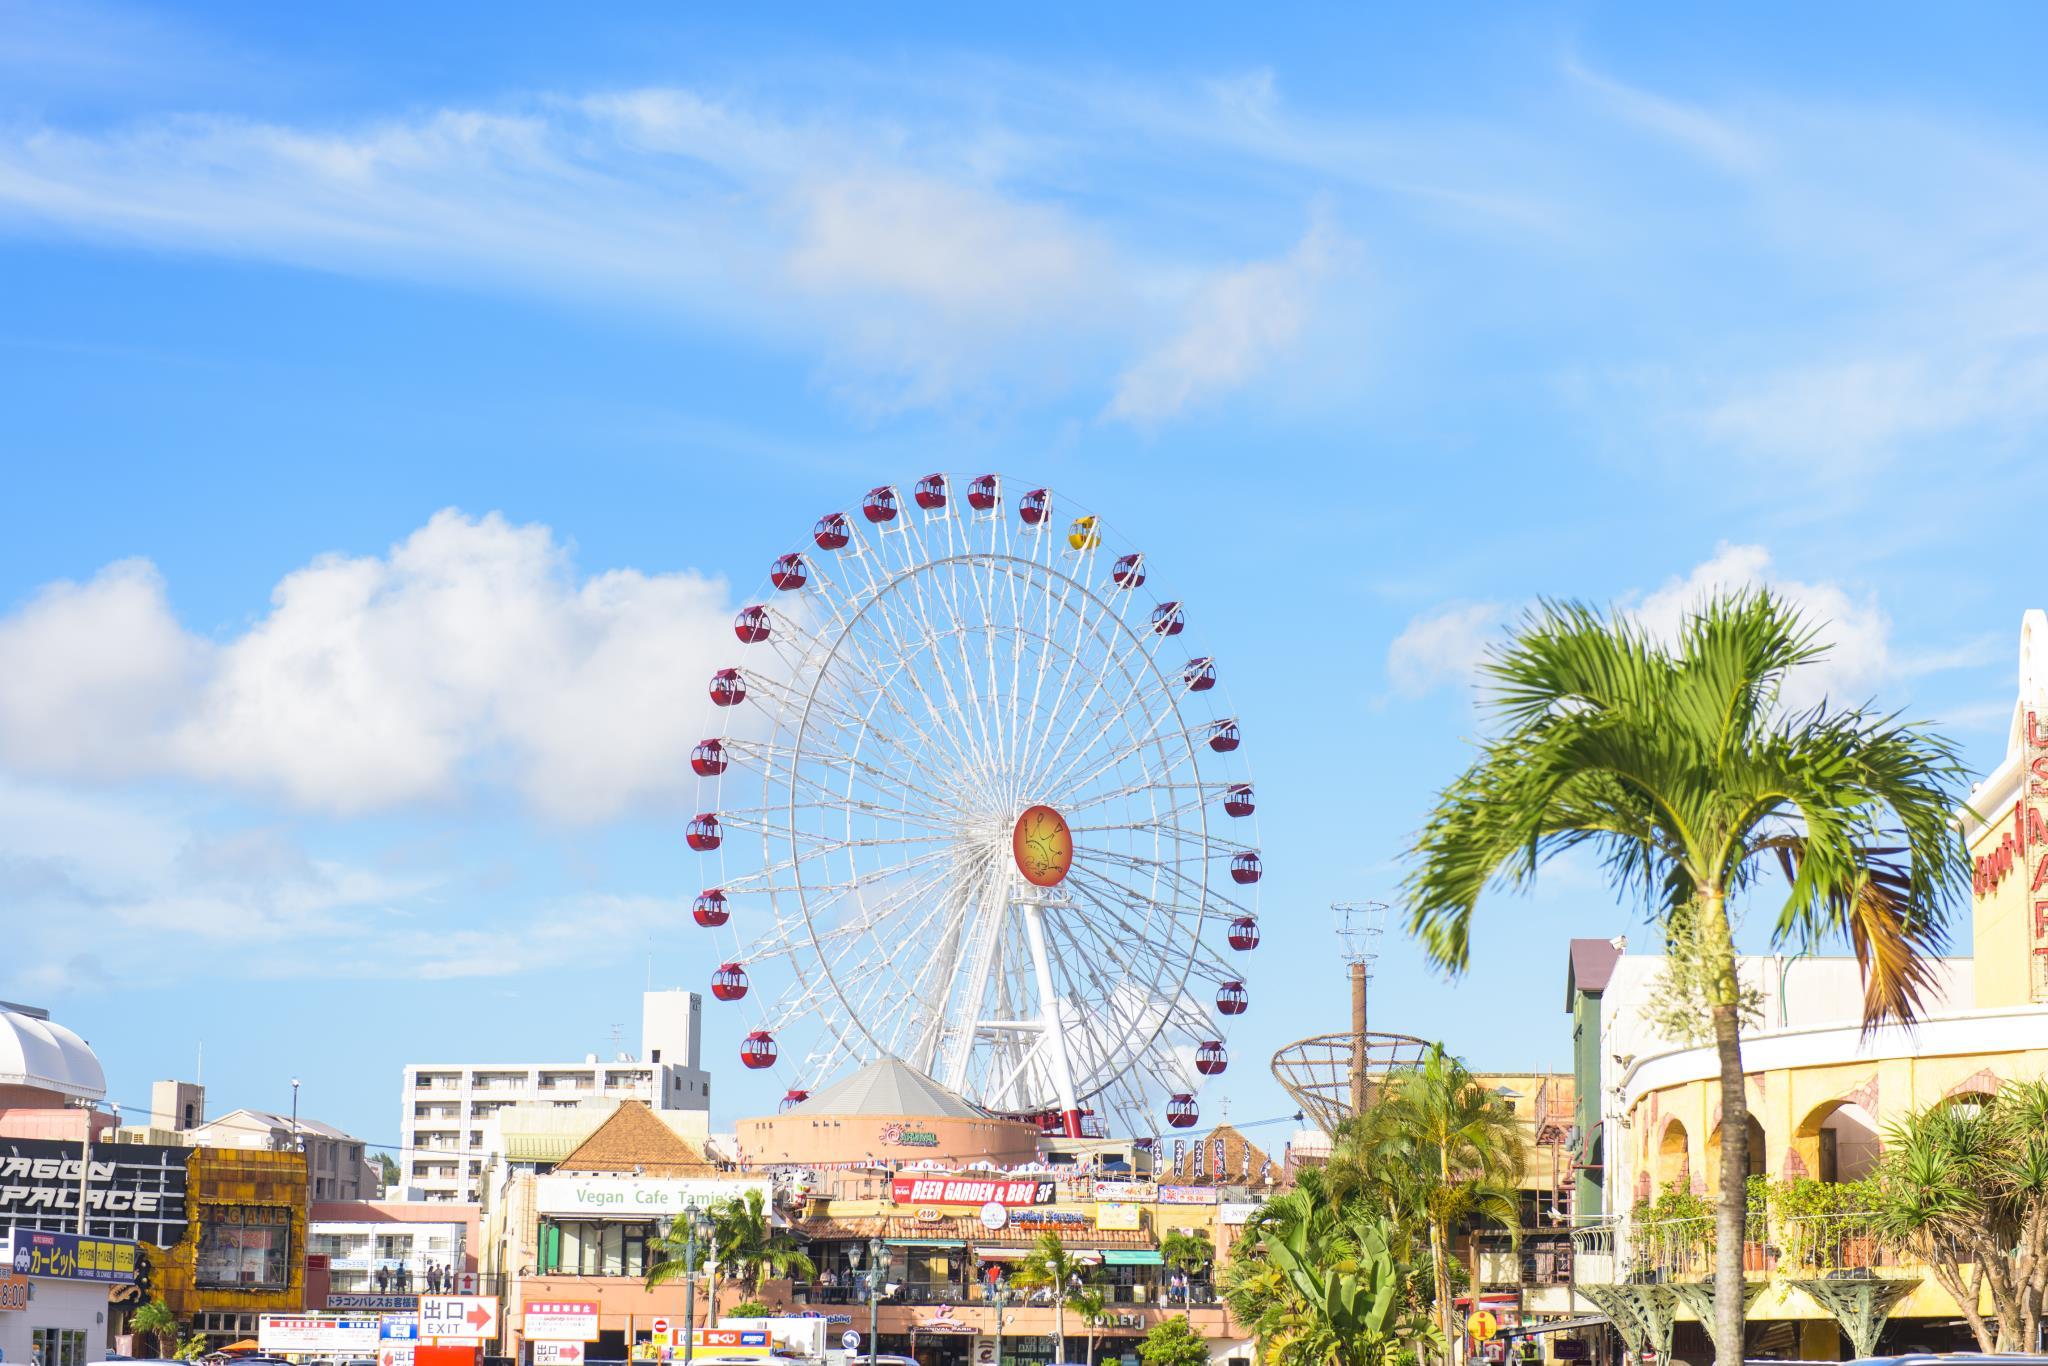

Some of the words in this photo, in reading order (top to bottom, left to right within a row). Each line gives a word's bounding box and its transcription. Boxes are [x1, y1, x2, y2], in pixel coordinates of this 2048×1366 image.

[0, 1185, 161, 1212] PALACE
[577, 1189, 624, 1206] Vegan
[635, 1190, 669, 1204] Cafe
[678, 1191, 738, 1205] Tamie's
[911, 1181, 944, 1201] BEER
[943, 1183, 995, 1202] GARDEN
[995, 1186, 1005, 1202] &
[1006, 1184, 1035, 1204] BBQ
[1036, 1183, 1054, 1203] 3F
[229, 1208, 287, 1225] GAME
[424, 1300, 464, 1320] 出口
[824, 1313, 851, 1323] obbins
[427, 1324, 460, 1334] EXIT
[537, 1344, 558, 1355] 出口
